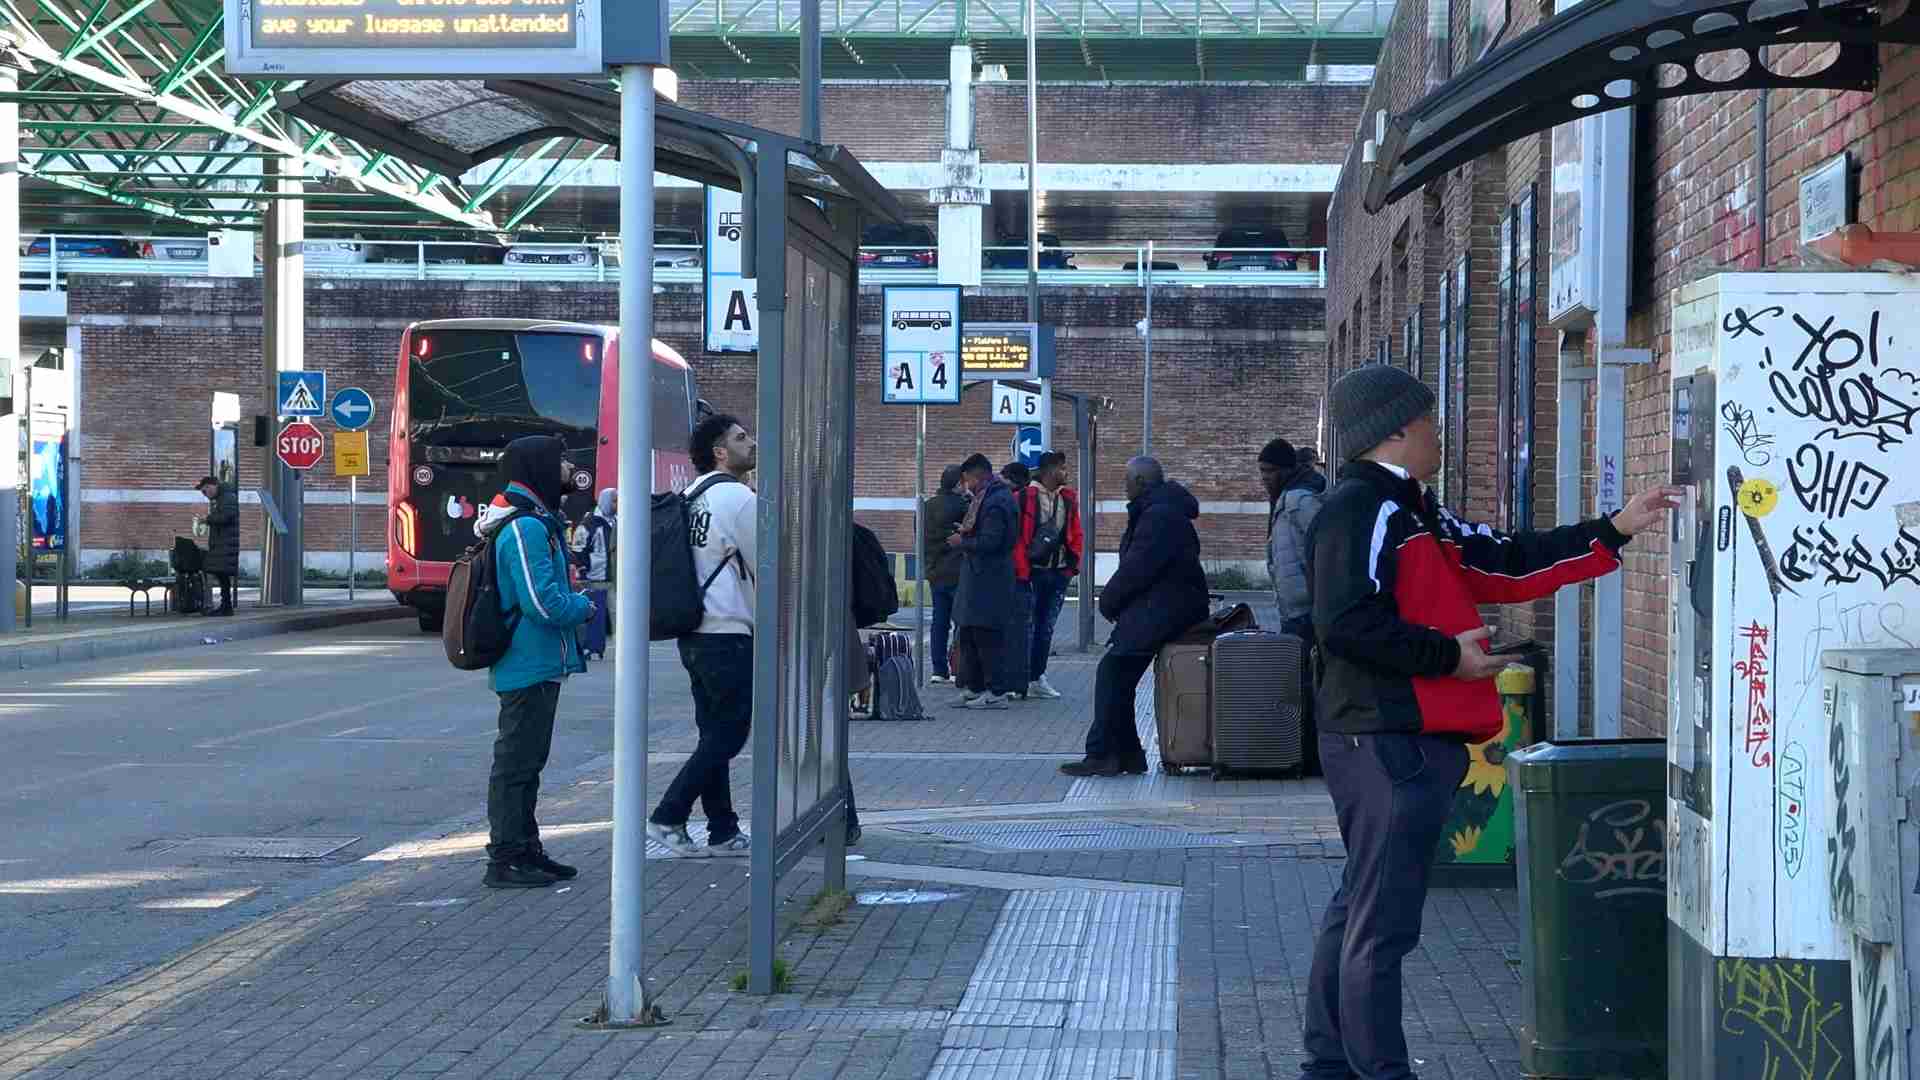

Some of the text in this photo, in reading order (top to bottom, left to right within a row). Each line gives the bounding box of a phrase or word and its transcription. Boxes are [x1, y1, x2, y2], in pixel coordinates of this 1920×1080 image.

[261, 16, 298, 34] ave
[304, 16, 353, 34] your
[452, 13, 569, 34] unattended
[724, 290, 752, 331] A
[896, 362, 947, 390] A 4
[999, 395, 1036, 415] A 5
[280, 437, 321, 454] STOP
